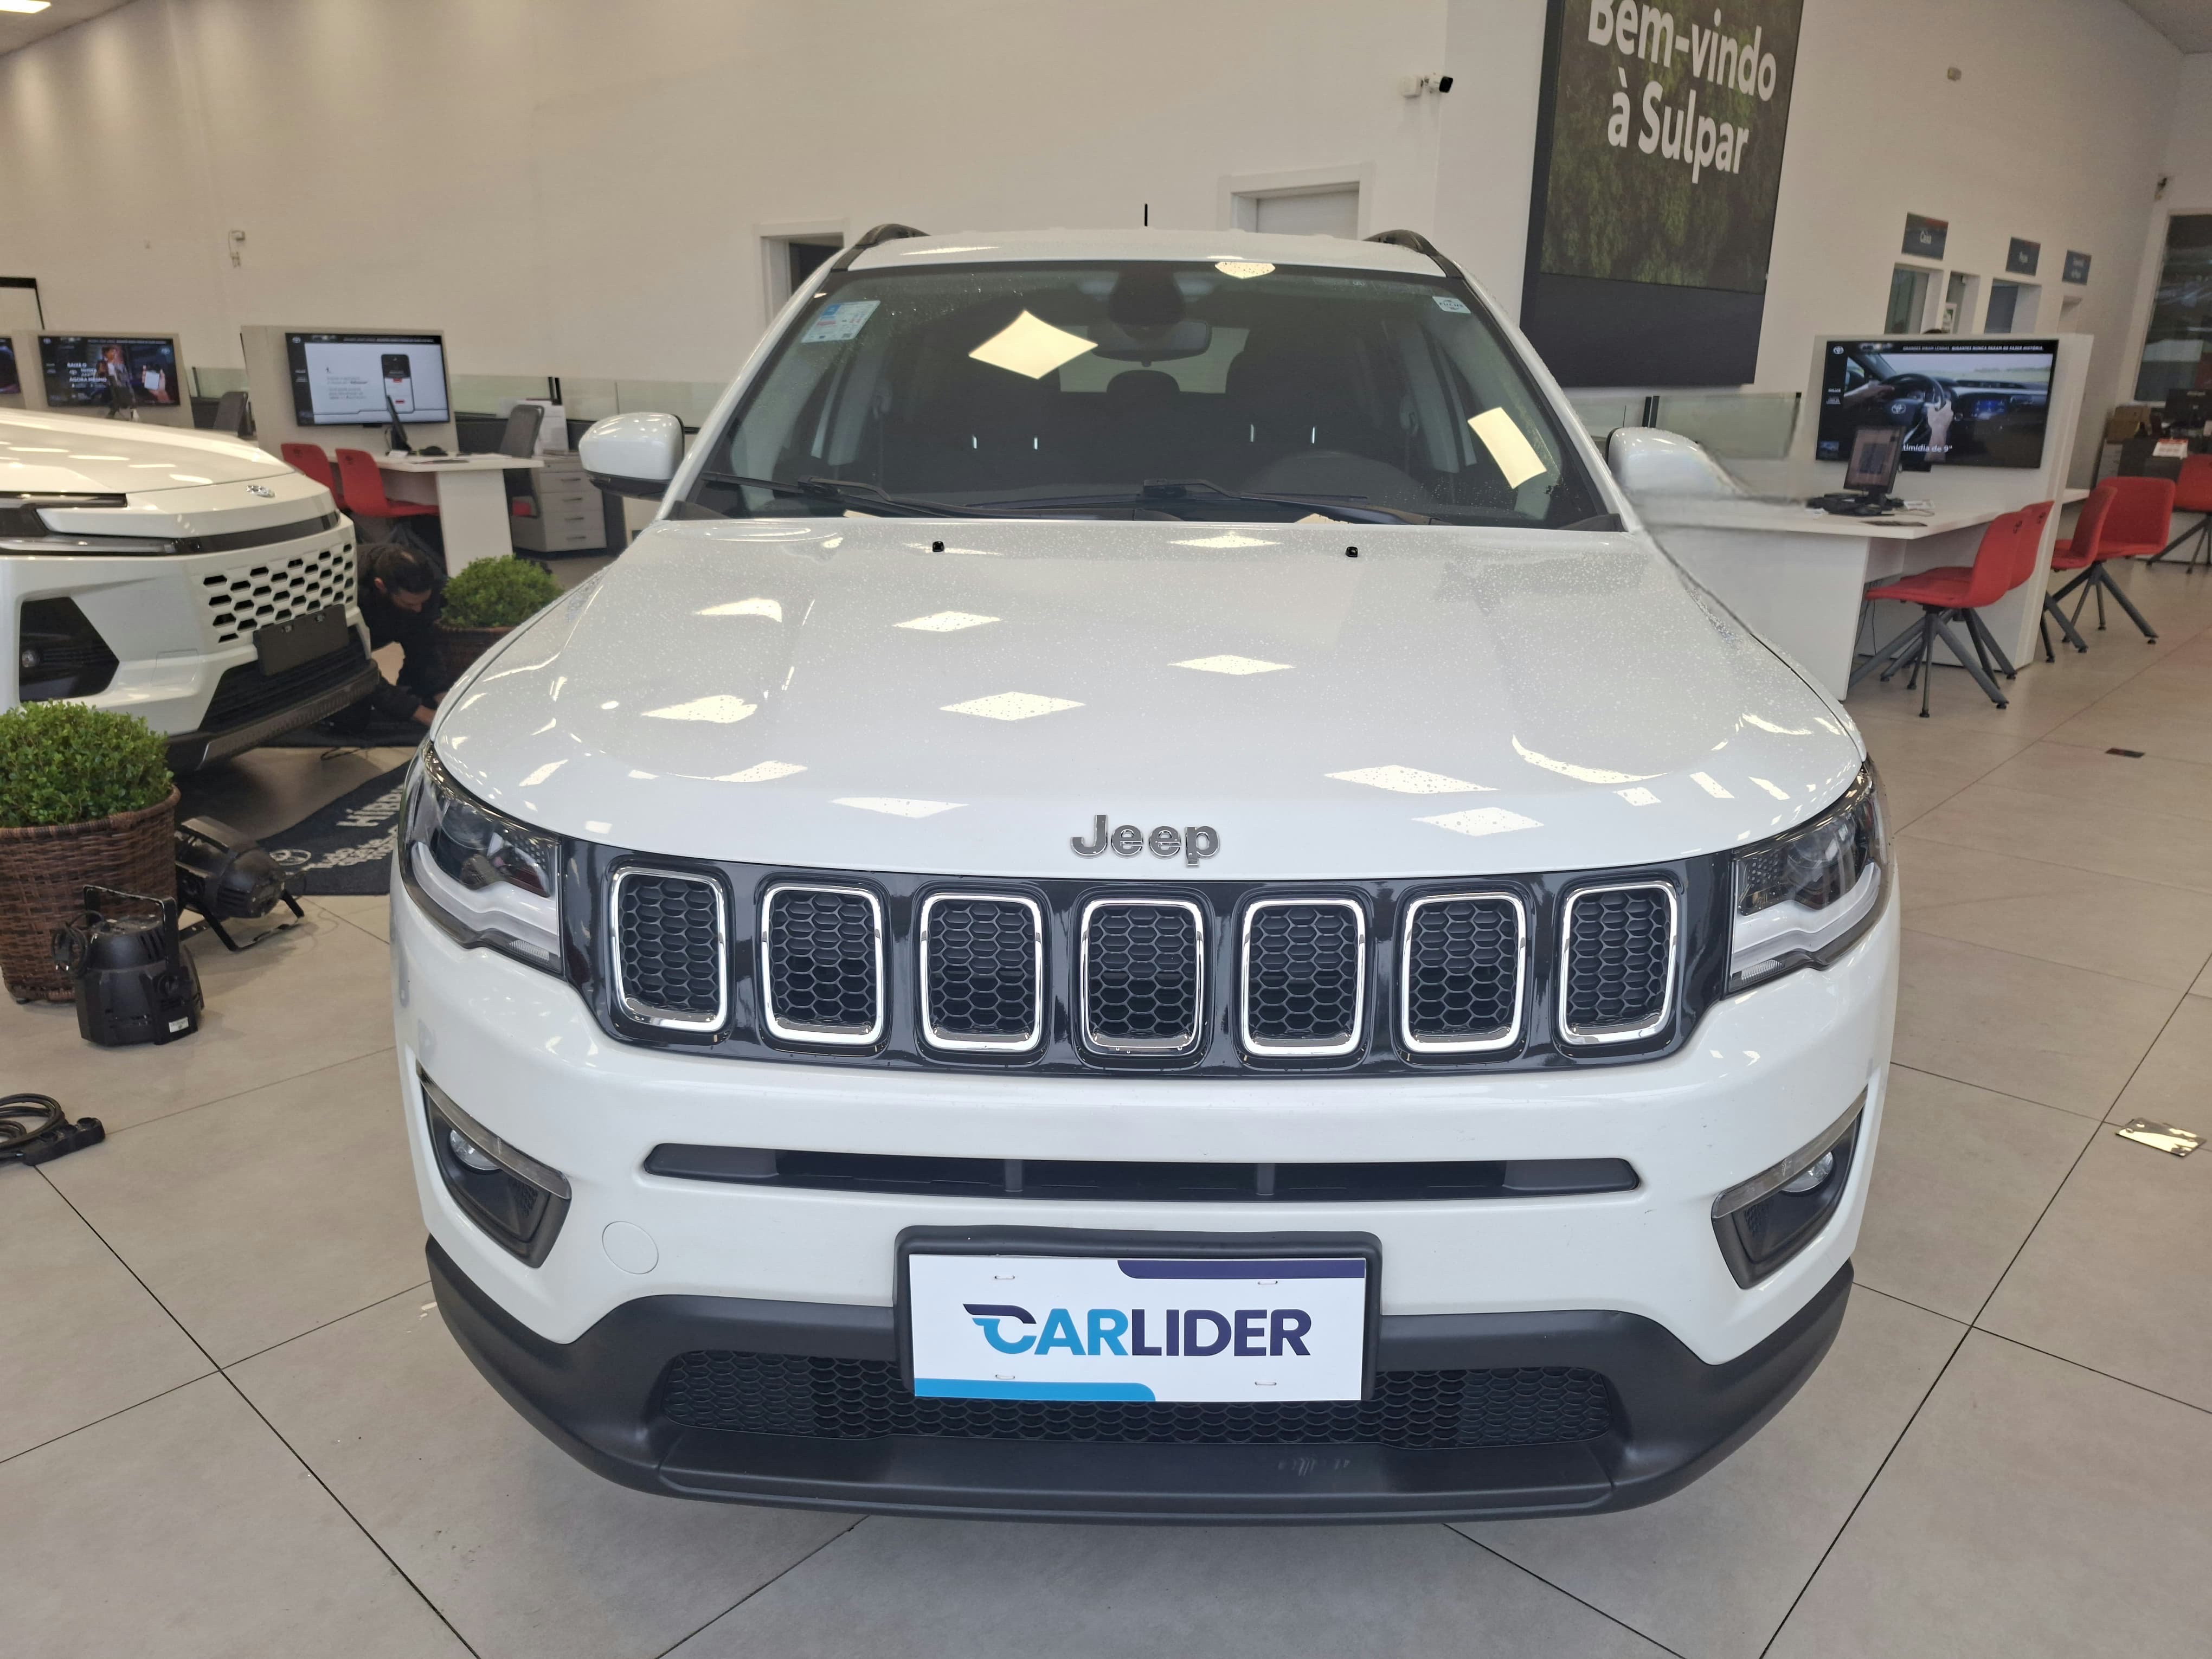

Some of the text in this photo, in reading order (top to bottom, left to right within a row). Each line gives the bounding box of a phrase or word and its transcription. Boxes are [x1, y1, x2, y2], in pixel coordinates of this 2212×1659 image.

[1588, 0, 1776, 101] Bem-vindo
[1607, 67, 1749, 184] à Sulpar
[1932, 444, 1941, 452] de
[1070, 814, 1221, 867] Jeep
[962, 1303, 1311, 1356] CARLIDER
